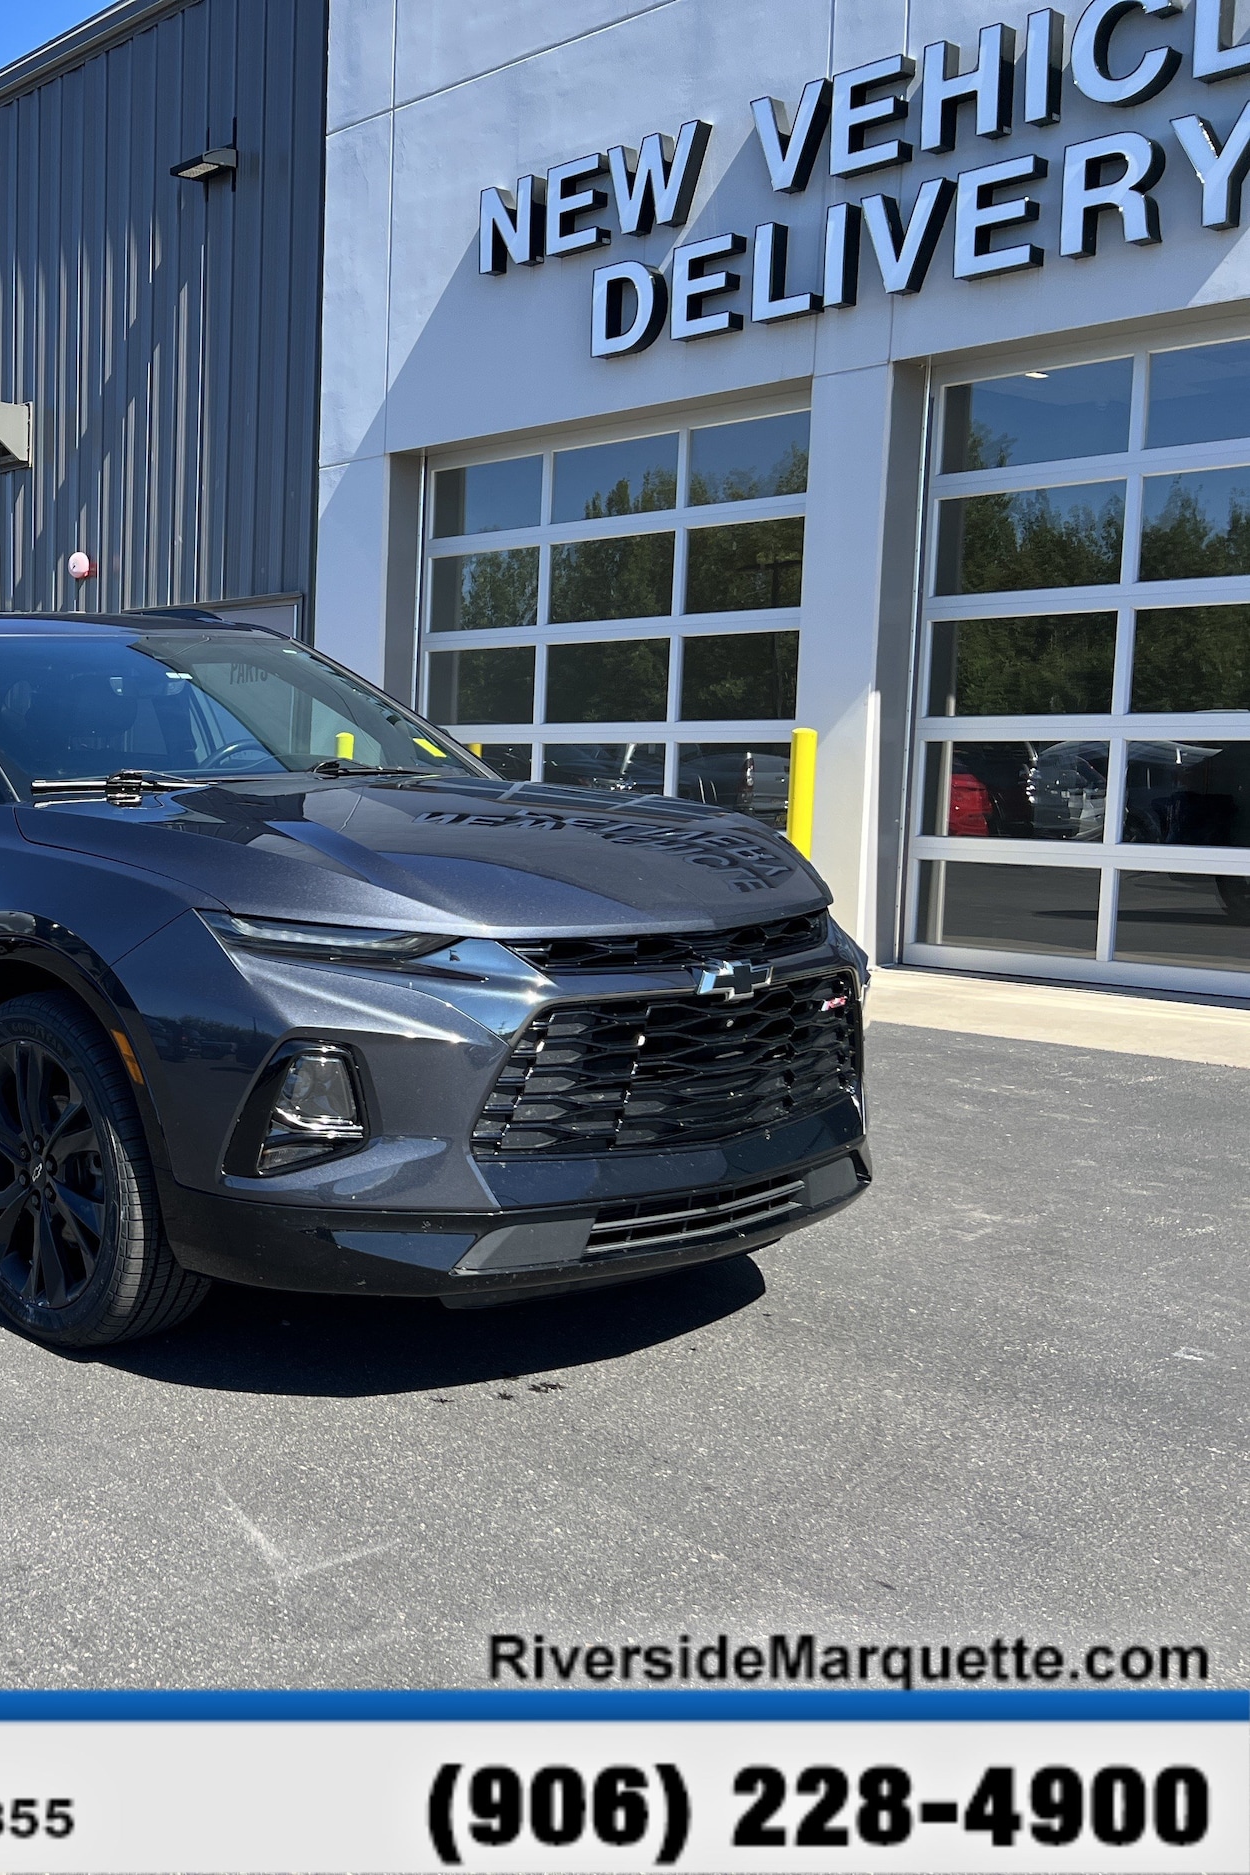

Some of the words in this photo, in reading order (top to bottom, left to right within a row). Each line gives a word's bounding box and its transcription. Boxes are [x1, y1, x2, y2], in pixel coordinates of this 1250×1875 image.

[479, 119, 712, 275] NEW
[590, 100, 1250, 359] DELIVERY
[230, 663, 268, 685] PARTS
